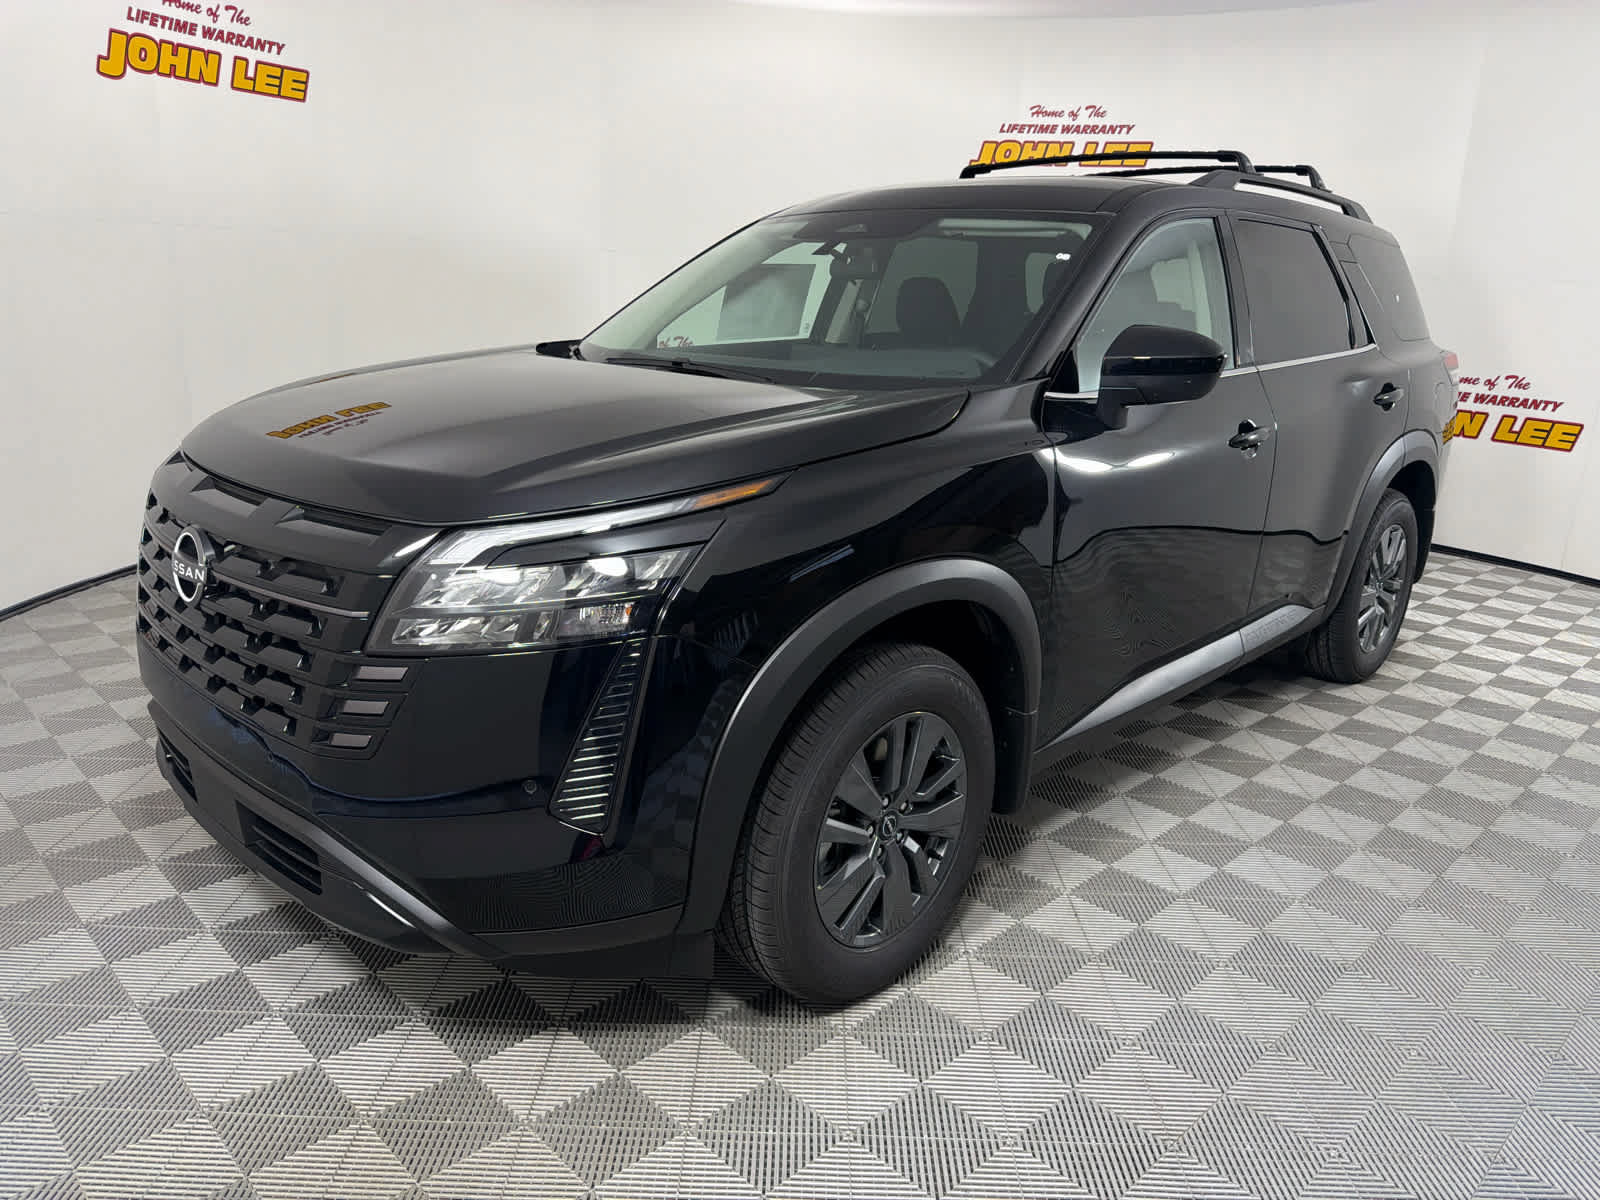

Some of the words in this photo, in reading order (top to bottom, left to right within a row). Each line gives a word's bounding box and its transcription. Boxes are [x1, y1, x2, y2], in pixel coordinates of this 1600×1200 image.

[206, 5, 221, 23] of
[225, 5, 251, 26] The
[127, 7, 198, 37] LIFETIME
[201, 25, 286, 56] WARRANTY
[97, 28, 222, 87] JOHN
[231, 56, 310, 102] LEE
[1030, 105, 1065, 118] Home
[1068, 106, 1081, 121] of
[1085, 105, 1107, 119] The
[1000, 123, 1058, 135] LIFETIME
[1060, 124, 1135, 135] WARRANTY
[969, 140, 1075, 167] JOHN
[1079, 141, 1154, 167] LEE
[1459, 376, 1480, 386] me
[1484, 376, 1500, 391] of
[1505, 375, 1530, 390] The
[1474, 392, 1564, 412] WARRANTY
[1491, 414, 1584, 453] LEE
[174, 560, 205, 582] SSAN
